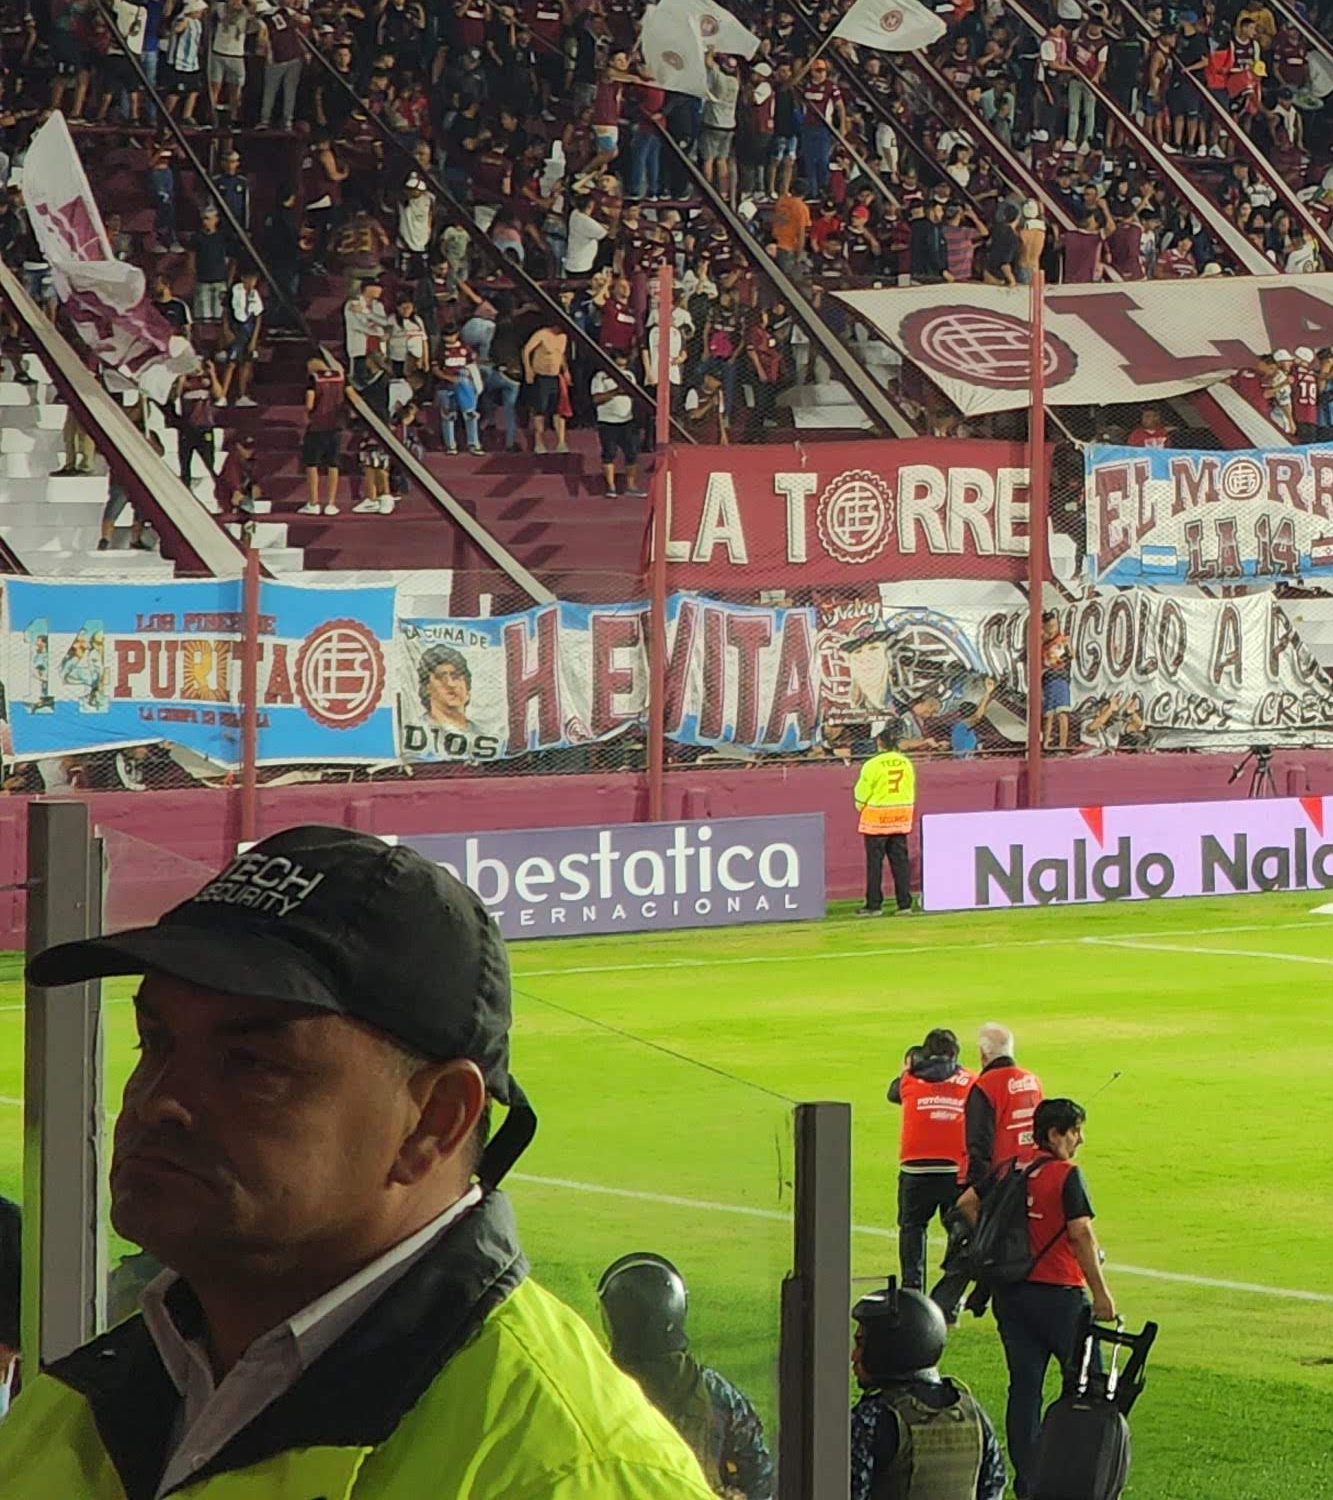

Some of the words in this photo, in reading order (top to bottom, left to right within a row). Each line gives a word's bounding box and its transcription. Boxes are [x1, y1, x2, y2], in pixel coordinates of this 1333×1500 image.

[1094, 461, 1156, 576] EL
[1184, 517, 1243, 581] LA
[1255, 514, 1300, 577] 14
[114, 640, 295, 704] PURITA
[469, 634, 489, 649] DE
[1211, 602, 1244, 688] A
[404, 725, 499, 759] DIOS
[887, 769, 904, 794] 3
[226, 853, 324, 899] TECH
[440, 826, 800, 906] bestatica
[975, 836, 1176, 906] Naldo
[488, 894, 799, 926] TERNACIONAL
